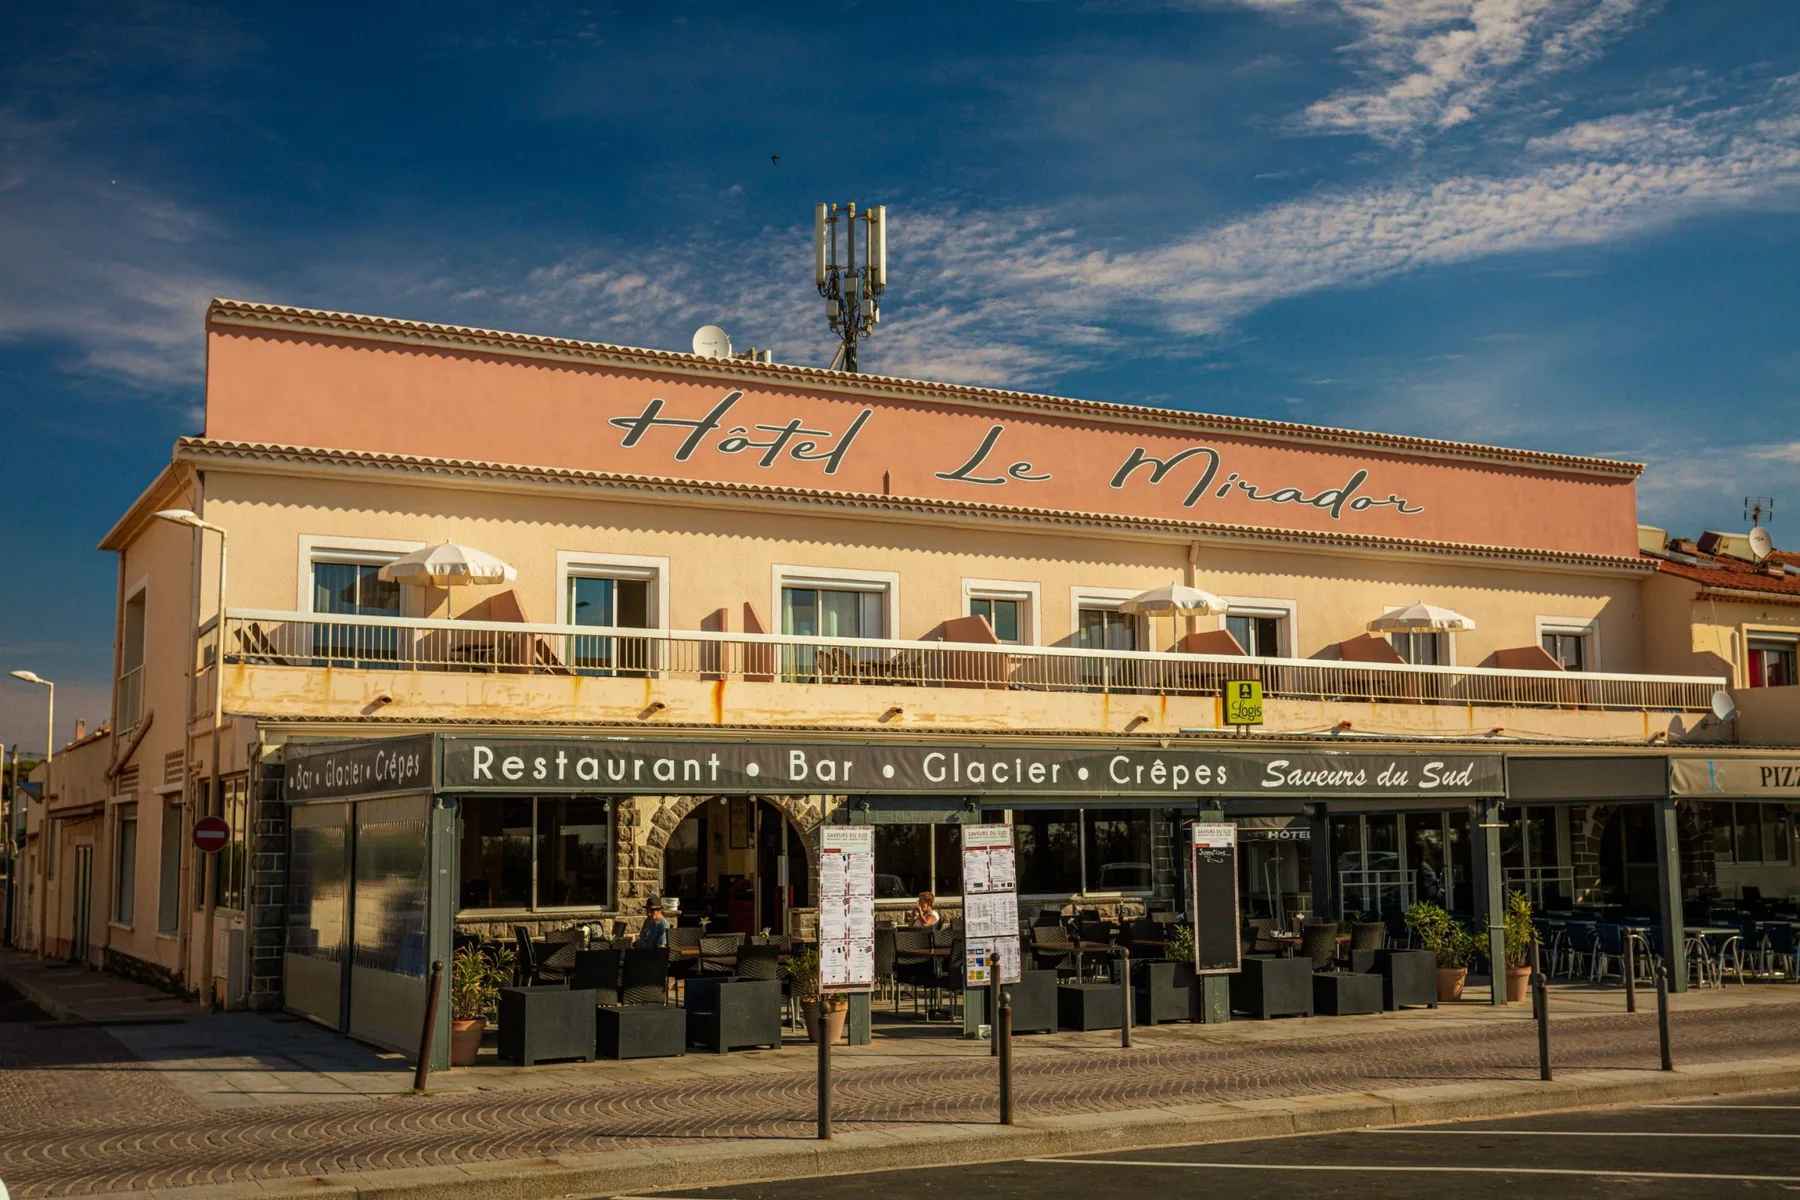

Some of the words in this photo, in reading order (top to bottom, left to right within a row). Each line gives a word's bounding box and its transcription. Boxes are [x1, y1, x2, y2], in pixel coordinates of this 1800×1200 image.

[607, 391, 873, 475] Hôtel
[934, 425, 1051, 485] Le
[1109, 446, 1424, 520] Mirador
[1231, 699, 1262, 721] Logis
[296, 764, 312, 790] Bar
[325, 758, 363, 787] Glacier
[375, 750, 420, 785] Crêpes
[473, 746, 720, 781] Restaurant
[788, 750, 853, 782] Bar
[923, 752, 1061, 784] Glacier
[1109, 755, 1227, 791] Crêpes
[1261, 760, 1368, 788] Saveurs
[1376, 762, 1408, 787] du
[1418, 761, 1474, 789] Sud
